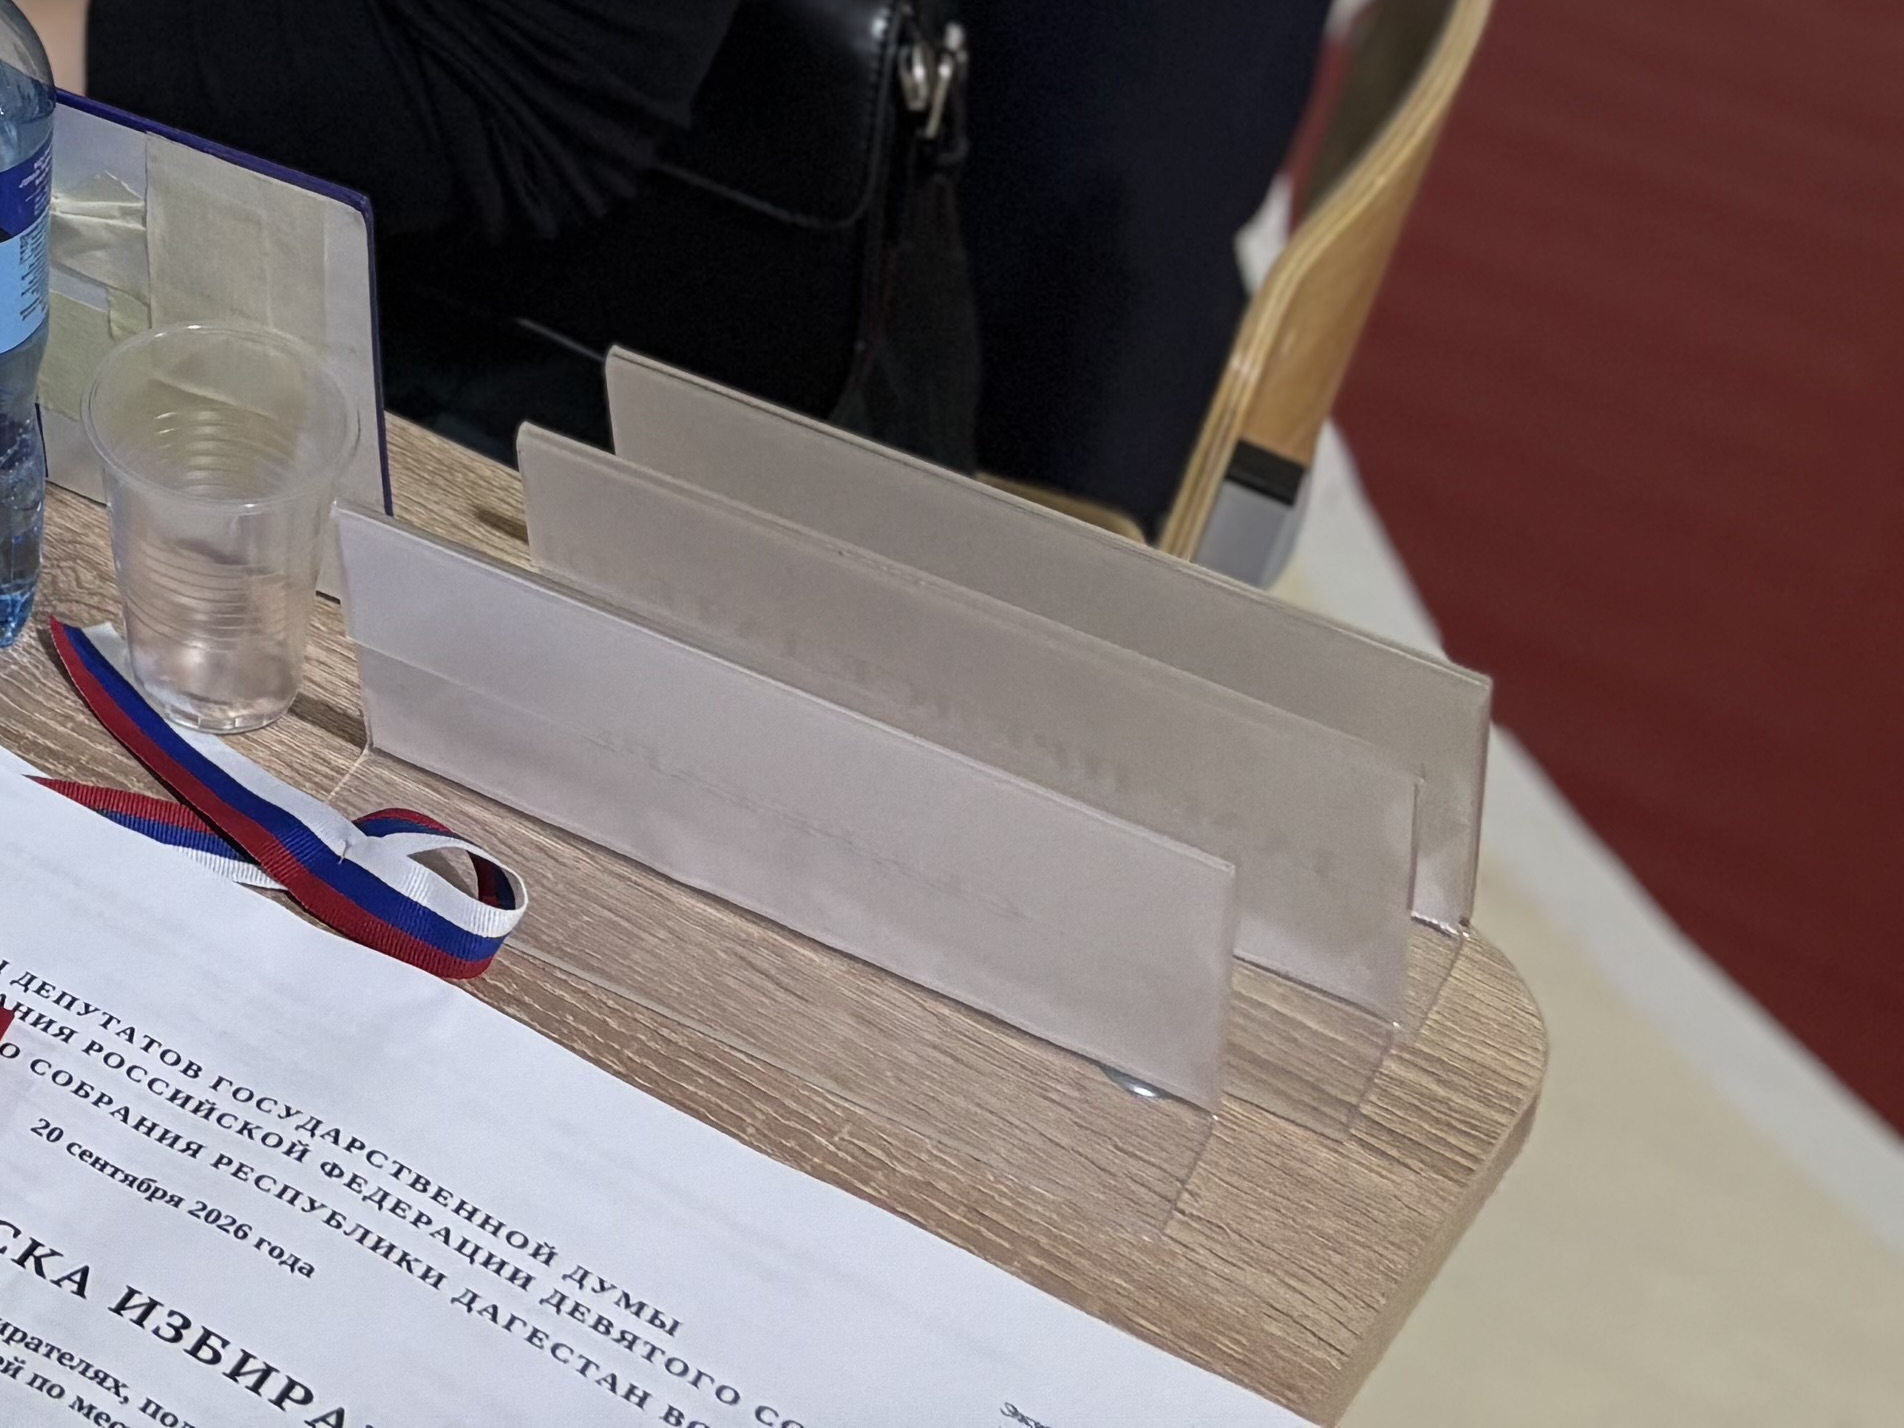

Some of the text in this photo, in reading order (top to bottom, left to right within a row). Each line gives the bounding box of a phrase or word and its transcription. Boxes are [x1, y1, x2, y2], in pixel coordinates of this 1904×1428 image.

[9, 971, 203, 1079] ДЕПУТАТОВ
[209, 1075, 558, 1267] ГОСУДАРСТВЕННОЙ
[561, 1265, 680, 1337] ДУМЫ
[29, 1058, 205, 1159] СОБРАНИЯ
[210, 1153, 447, 1290] РЕСПУБЛИКИ
[450, 1288, 652, 1410] ДАГЕСТАН
[30, 1118, 315, 1279] 20 сентября 2026 года
[81, 1039, 311, 1164] РОССИЙСКОЙ
[319, 1161, 535, 1292] ФЕДЕРАЦИИ
[538, 1288, 741, 1406] ДЕВЯТОГО
[25, 1372, 66, 1400] по
[107, 1284, 374, 1428] ИЗБИРА
